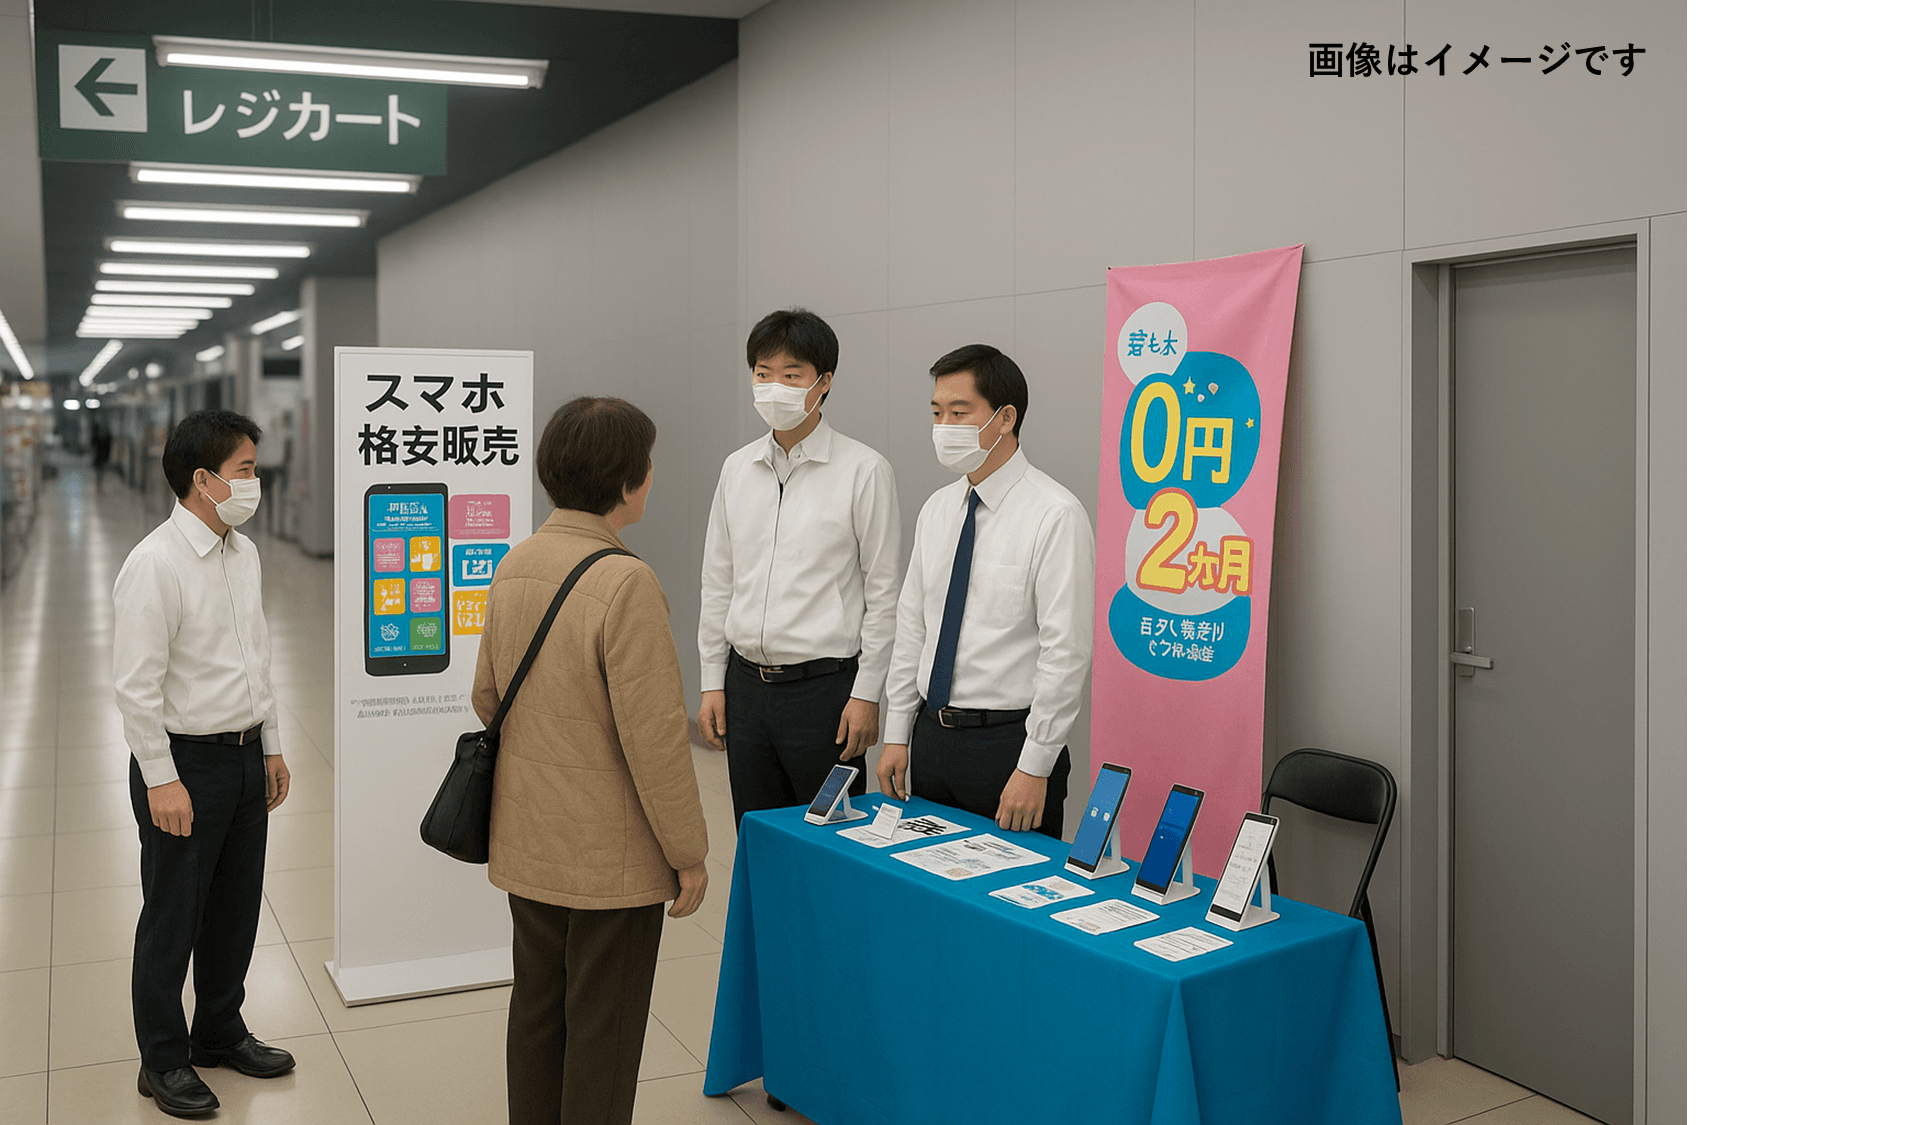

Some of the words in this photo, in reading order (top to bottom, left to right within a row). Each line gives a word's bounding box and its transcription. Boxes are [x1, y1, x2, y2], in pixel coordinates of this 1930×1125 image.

[183, 89, 421, 146] レジカート
[365, 373, 505, 413] スマホ
[358, 423, 520, 467] 格安販売
[1131, 382, 1234, 484] 0円
